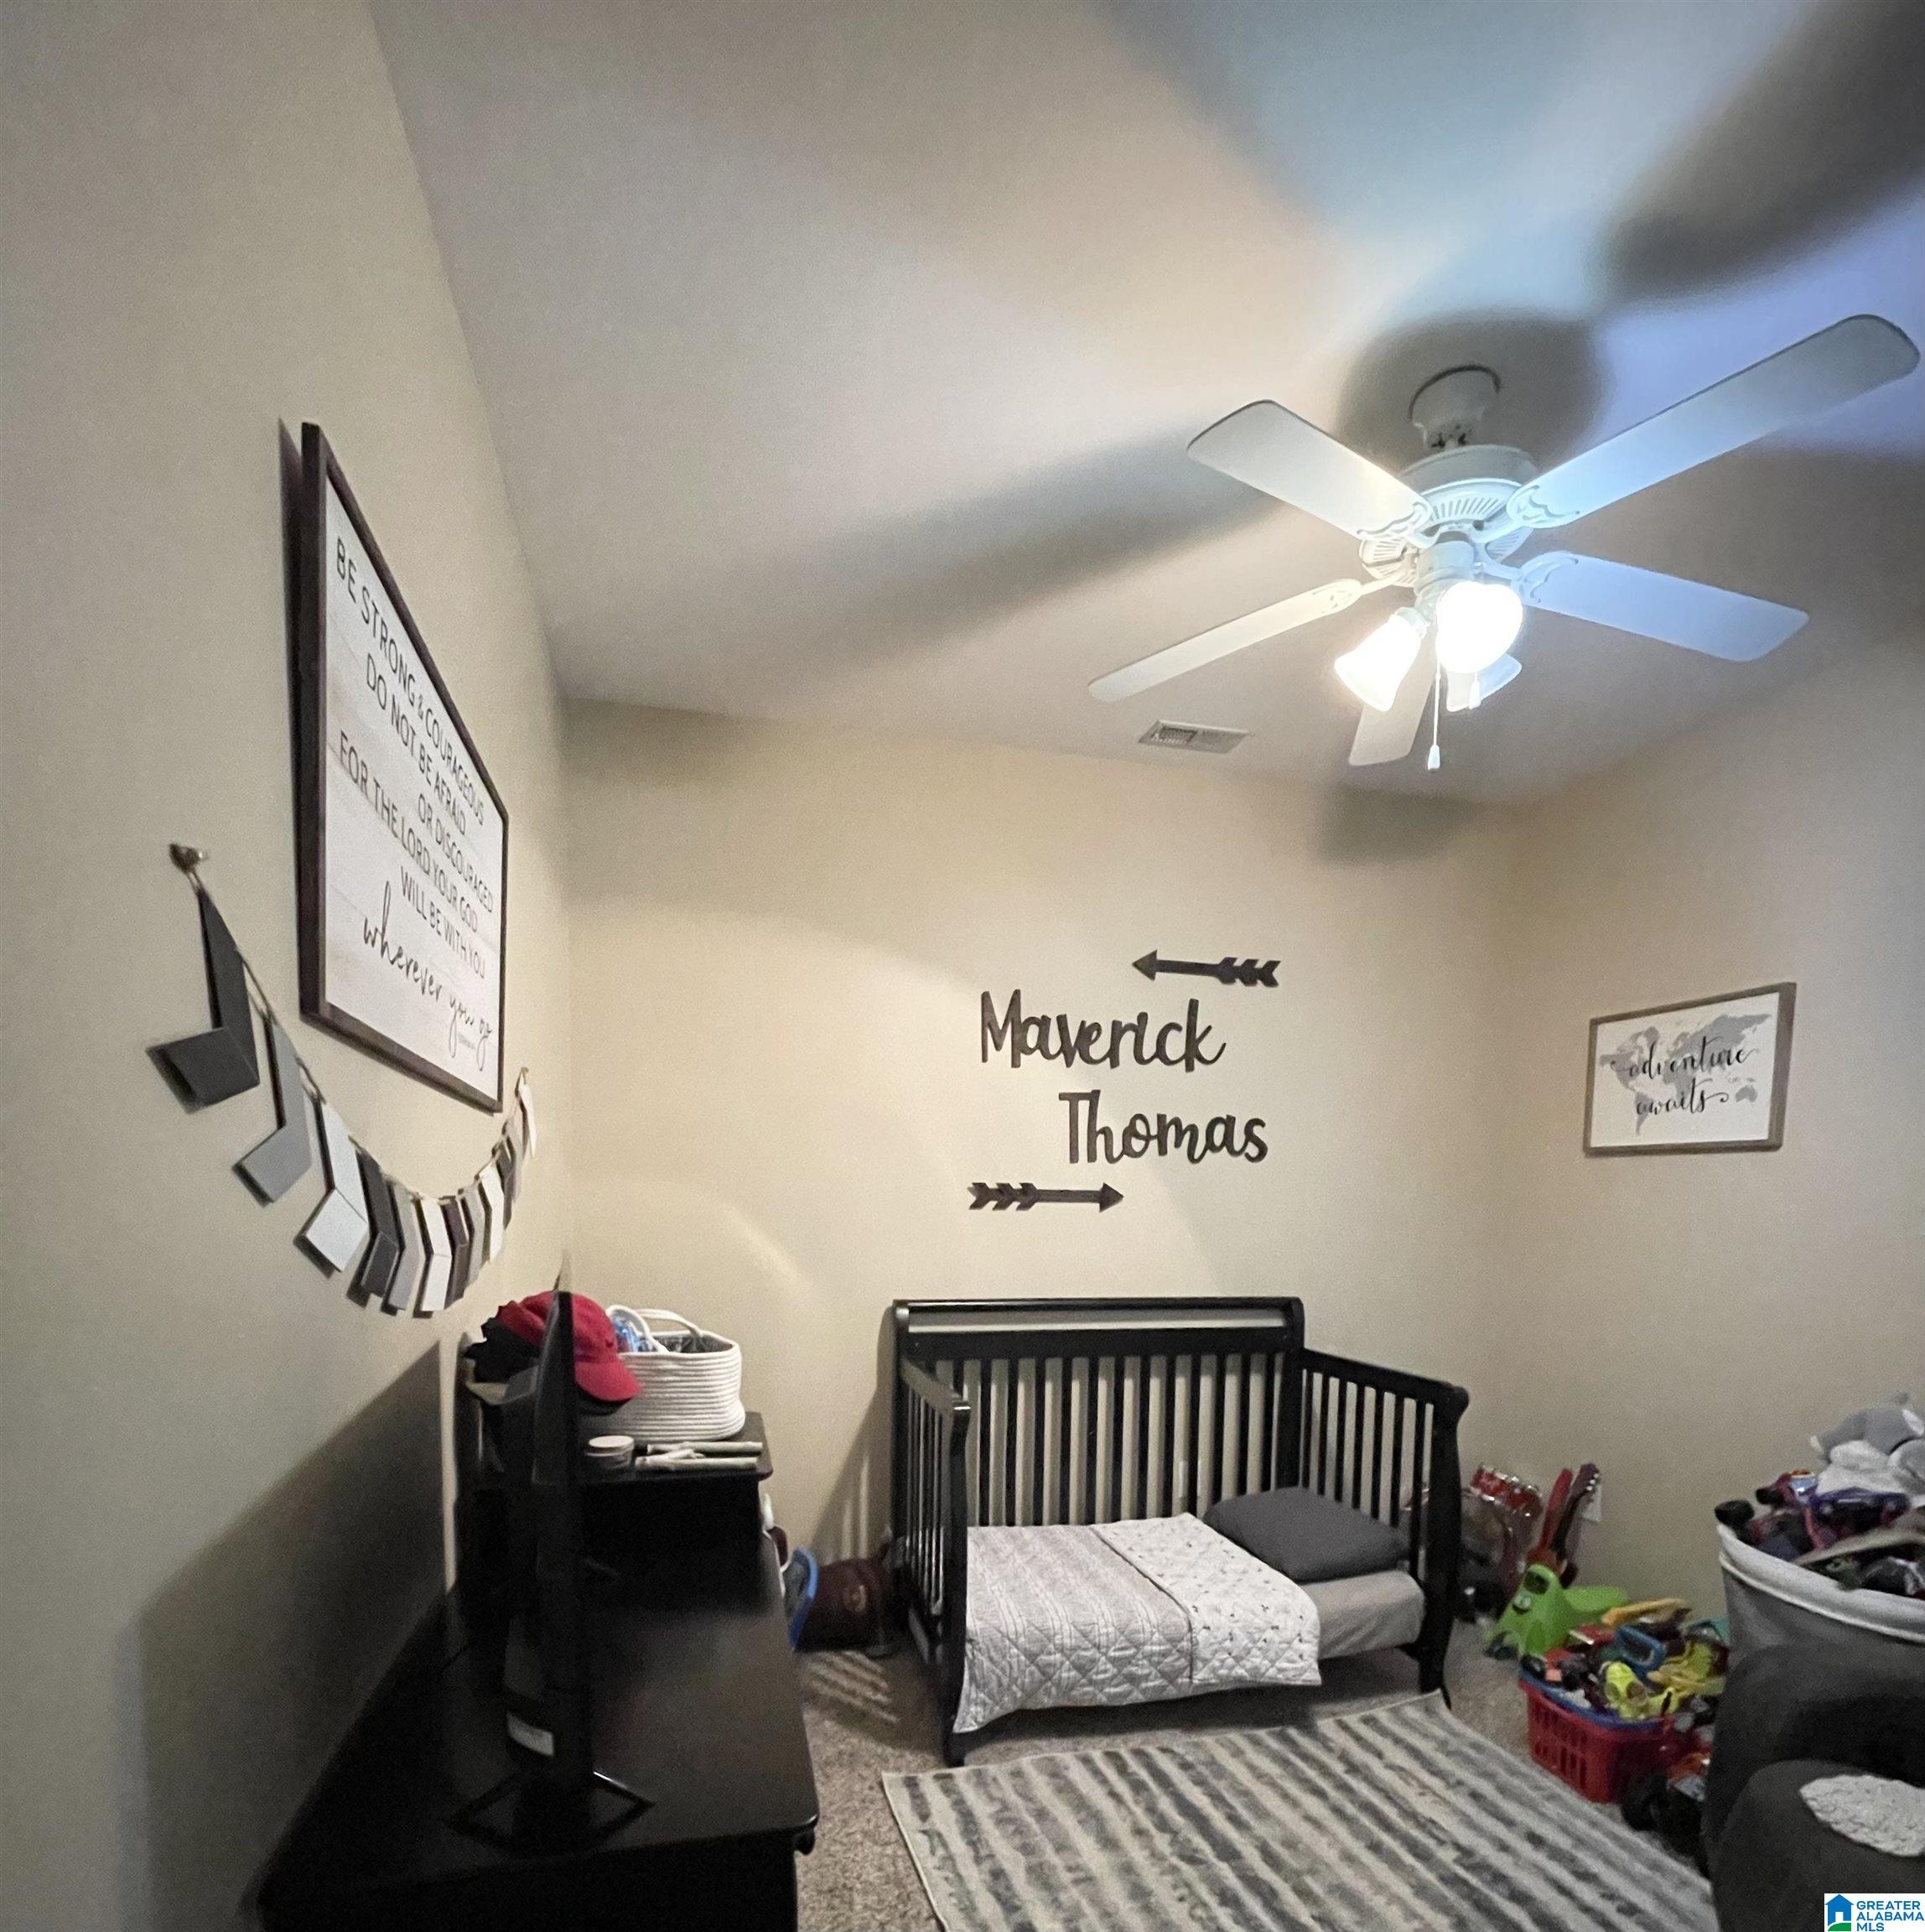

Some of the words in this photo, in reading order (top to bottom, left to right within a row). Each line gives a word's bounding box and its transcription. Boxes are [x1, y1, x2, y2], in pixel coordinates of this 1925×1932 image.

[337, 536, 356, 604] BE
[361, 585, 416, 707] STRONG
[426, 708, 484, 826] COURAGEOUS
[366, 652, 387, 710] DO
[392, 694, 416, 756] NOT
[419, 742, 433, 787] BE
[434, 771, 466, 835] AFRAID
[340, 730, 368, 797] FOR
[373, 776, 398, 839] THE
[402, 816, 431, 875] LORD
[433, 859, 458, 911] YOUR
[460, 896, 478, 932] GOD
[418, 793, 433, 836] OR
[436, 818, 493, 913] DISCOURAGED
[363, 880, 442, 1001] wherever
[401, 865, 427, 921] WILL
[430, 901, 441, 936] BE
[444, 915, 467, 962] WITH
[469, 943, 485, 979] YOU
[980, 989, 1227, 1073] Maverick
[1610, 1036, 1759, 1079] adventure
[1058, 1088, 1269, 1165] Thomas
[1637, 1078, 1729, 1115] awaits
